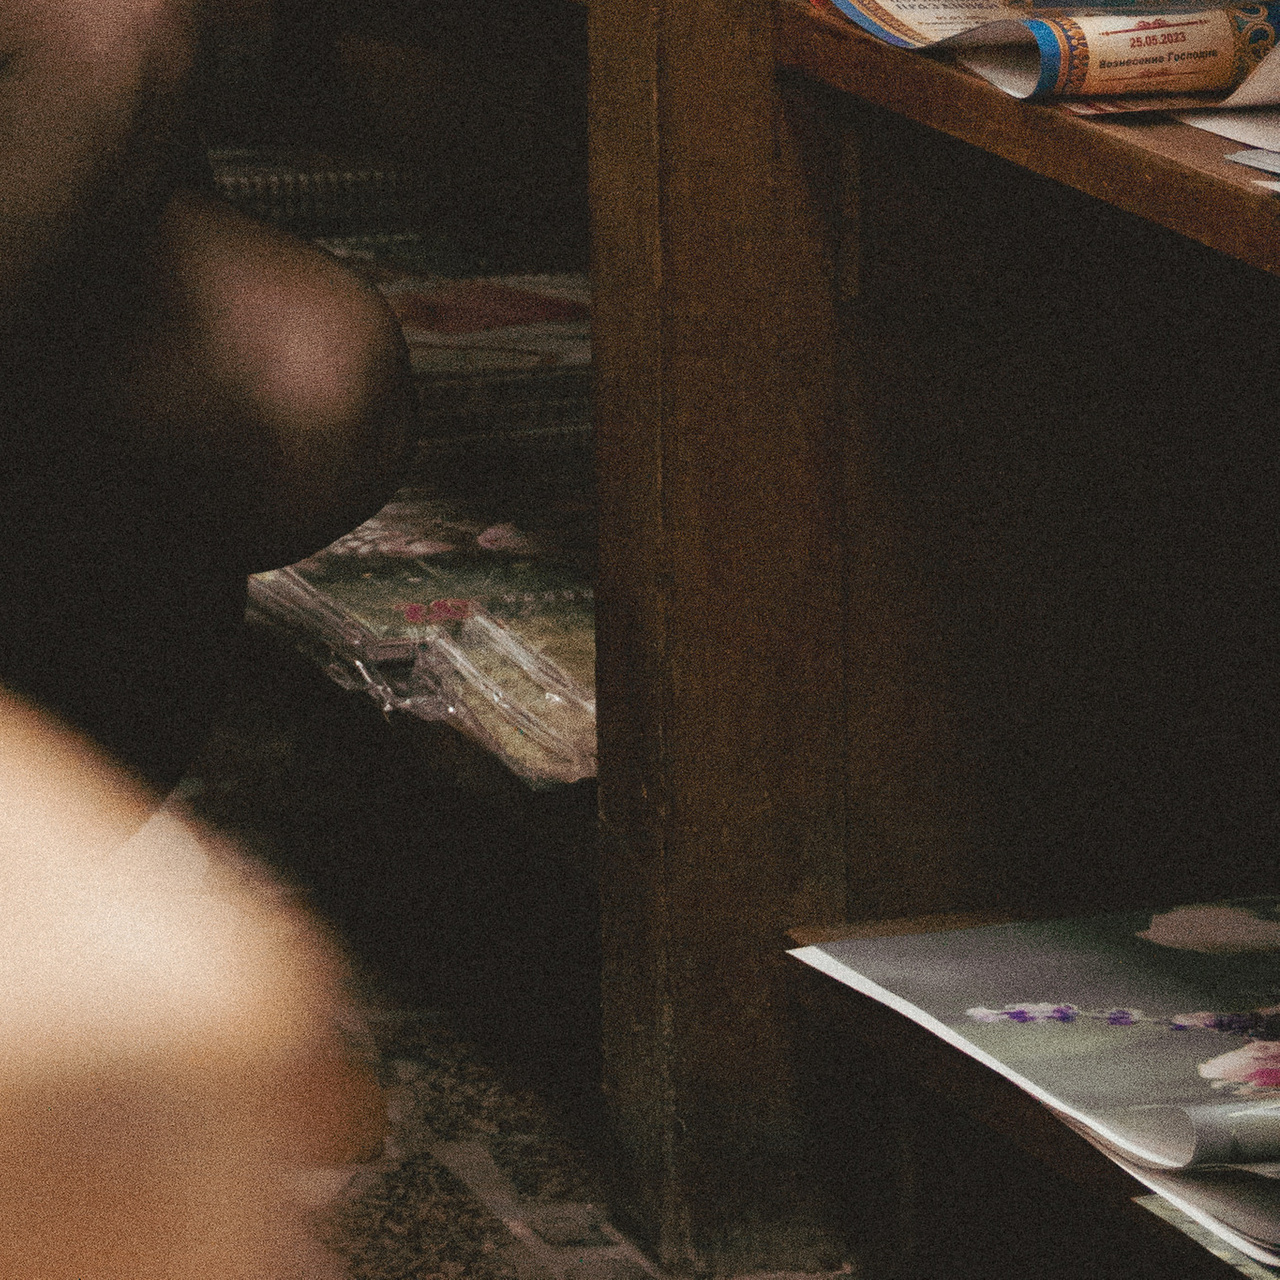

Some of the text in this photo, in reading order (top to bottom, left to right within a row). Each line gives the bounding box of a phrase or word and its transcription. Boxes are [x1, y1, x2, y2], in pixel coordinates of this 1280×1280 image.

[1129, 32, 1186, 48] 25.05.2023
[1098, 49, 1218, 69] Вознесение Господне
